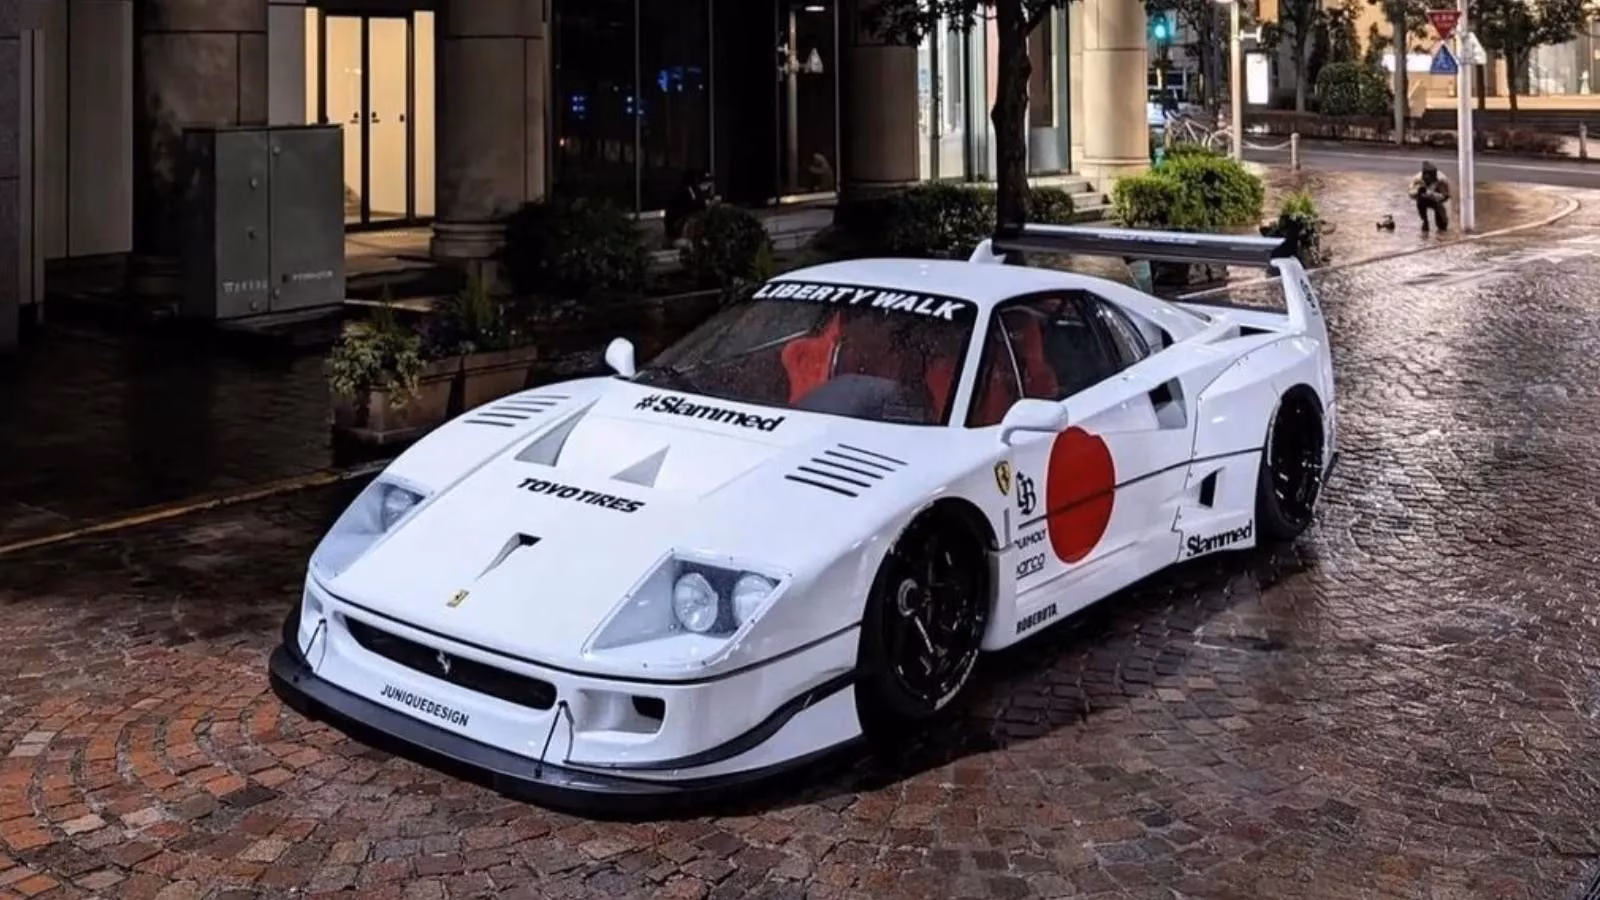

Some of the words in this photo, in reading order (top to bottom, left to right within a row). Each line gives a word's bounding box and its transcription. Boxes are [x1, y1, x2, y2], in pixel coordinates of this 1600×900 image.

[752, 283, 875, 304] LIBERTY
[871, 291, 965, 320] WALK
[634, 394, 785, 431] #Slammed
[517, 477, 581, 499] TOYO
[575, 490, 646, 513] TIRES
[1187, 518, 1253, 557] Slammed
[1016, 552, 1045, 574] arco
[380, 684, 469, 726] JUNIQUEDESIGN
